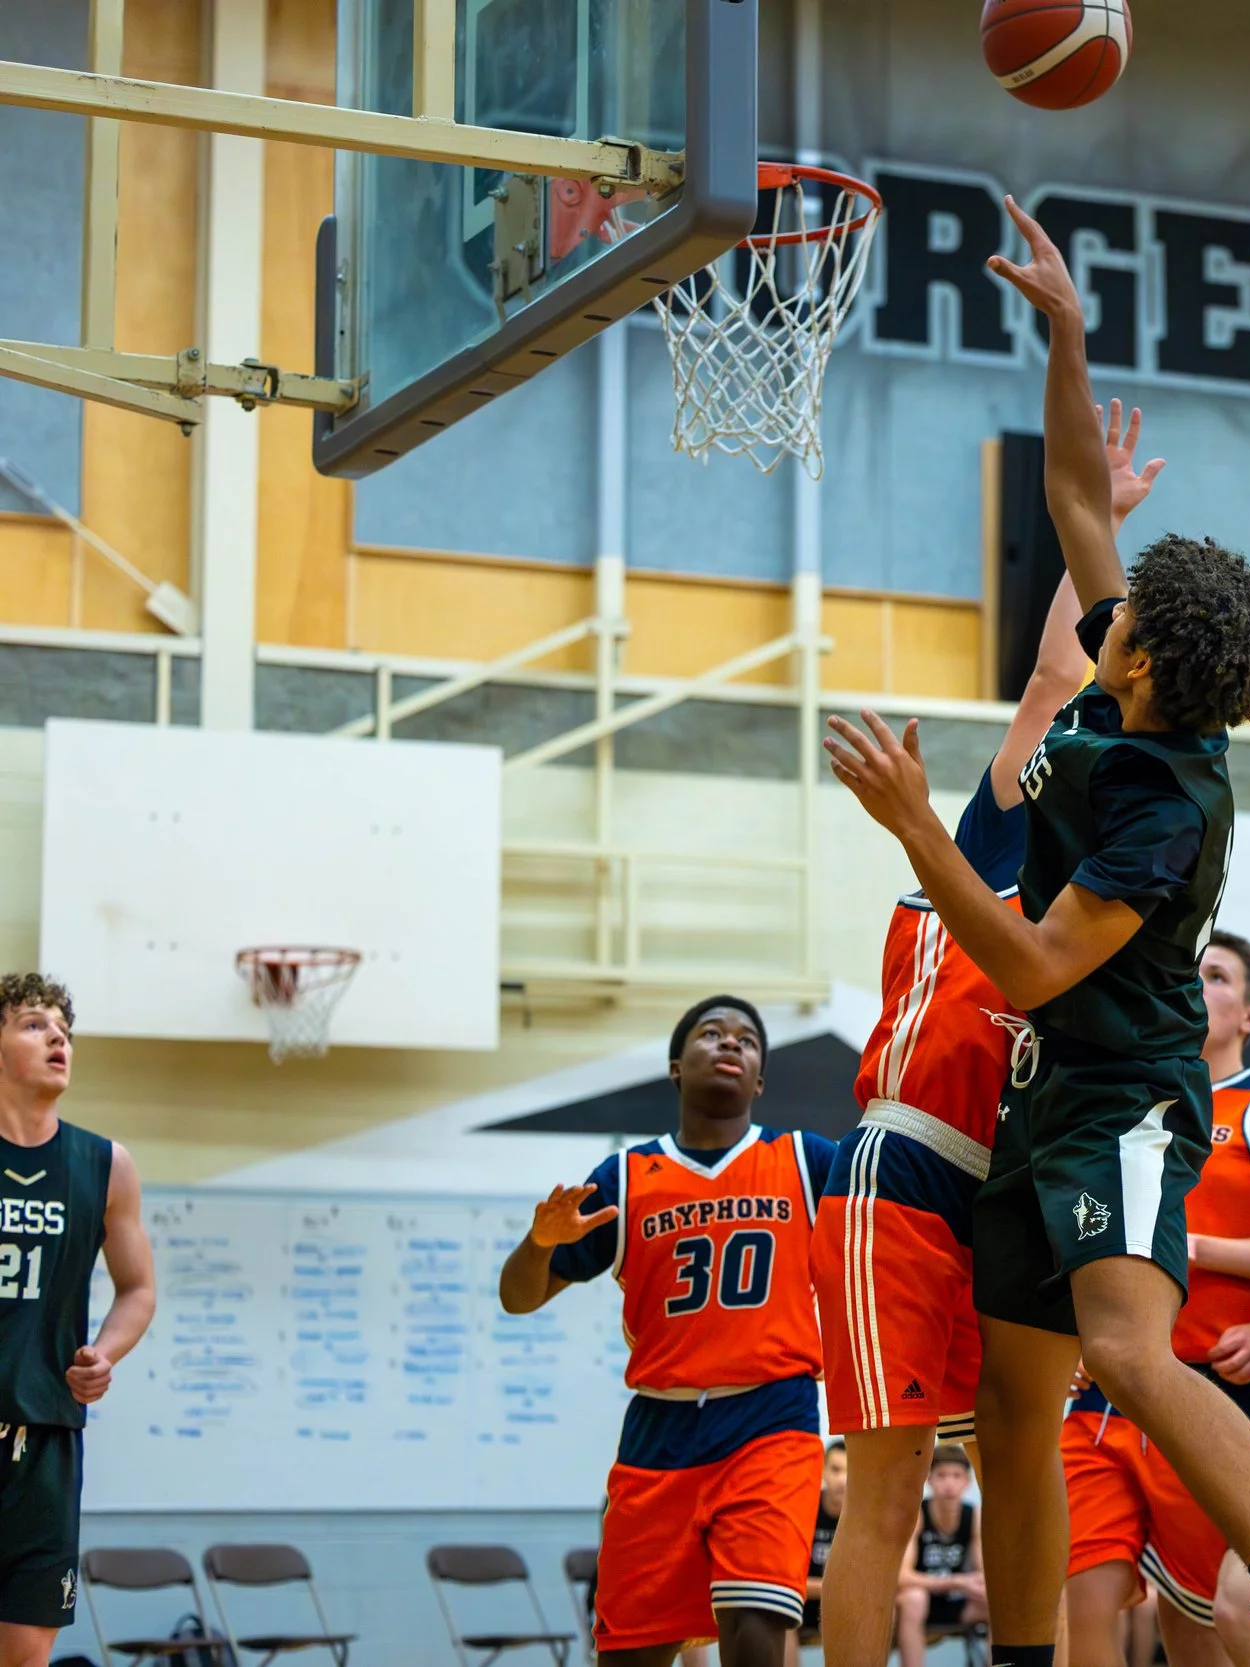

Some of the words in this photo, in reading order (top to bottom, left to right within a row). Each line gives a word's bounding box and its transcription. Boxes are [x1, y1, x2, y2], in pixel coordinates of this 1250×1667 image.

[0, 1197, 66, 1235] ESS
[642, 1196, 793, 1240] GRYPHONS
[0, 1243, 43, 1300] 21
[665, 1229, 776, 1318] 30
